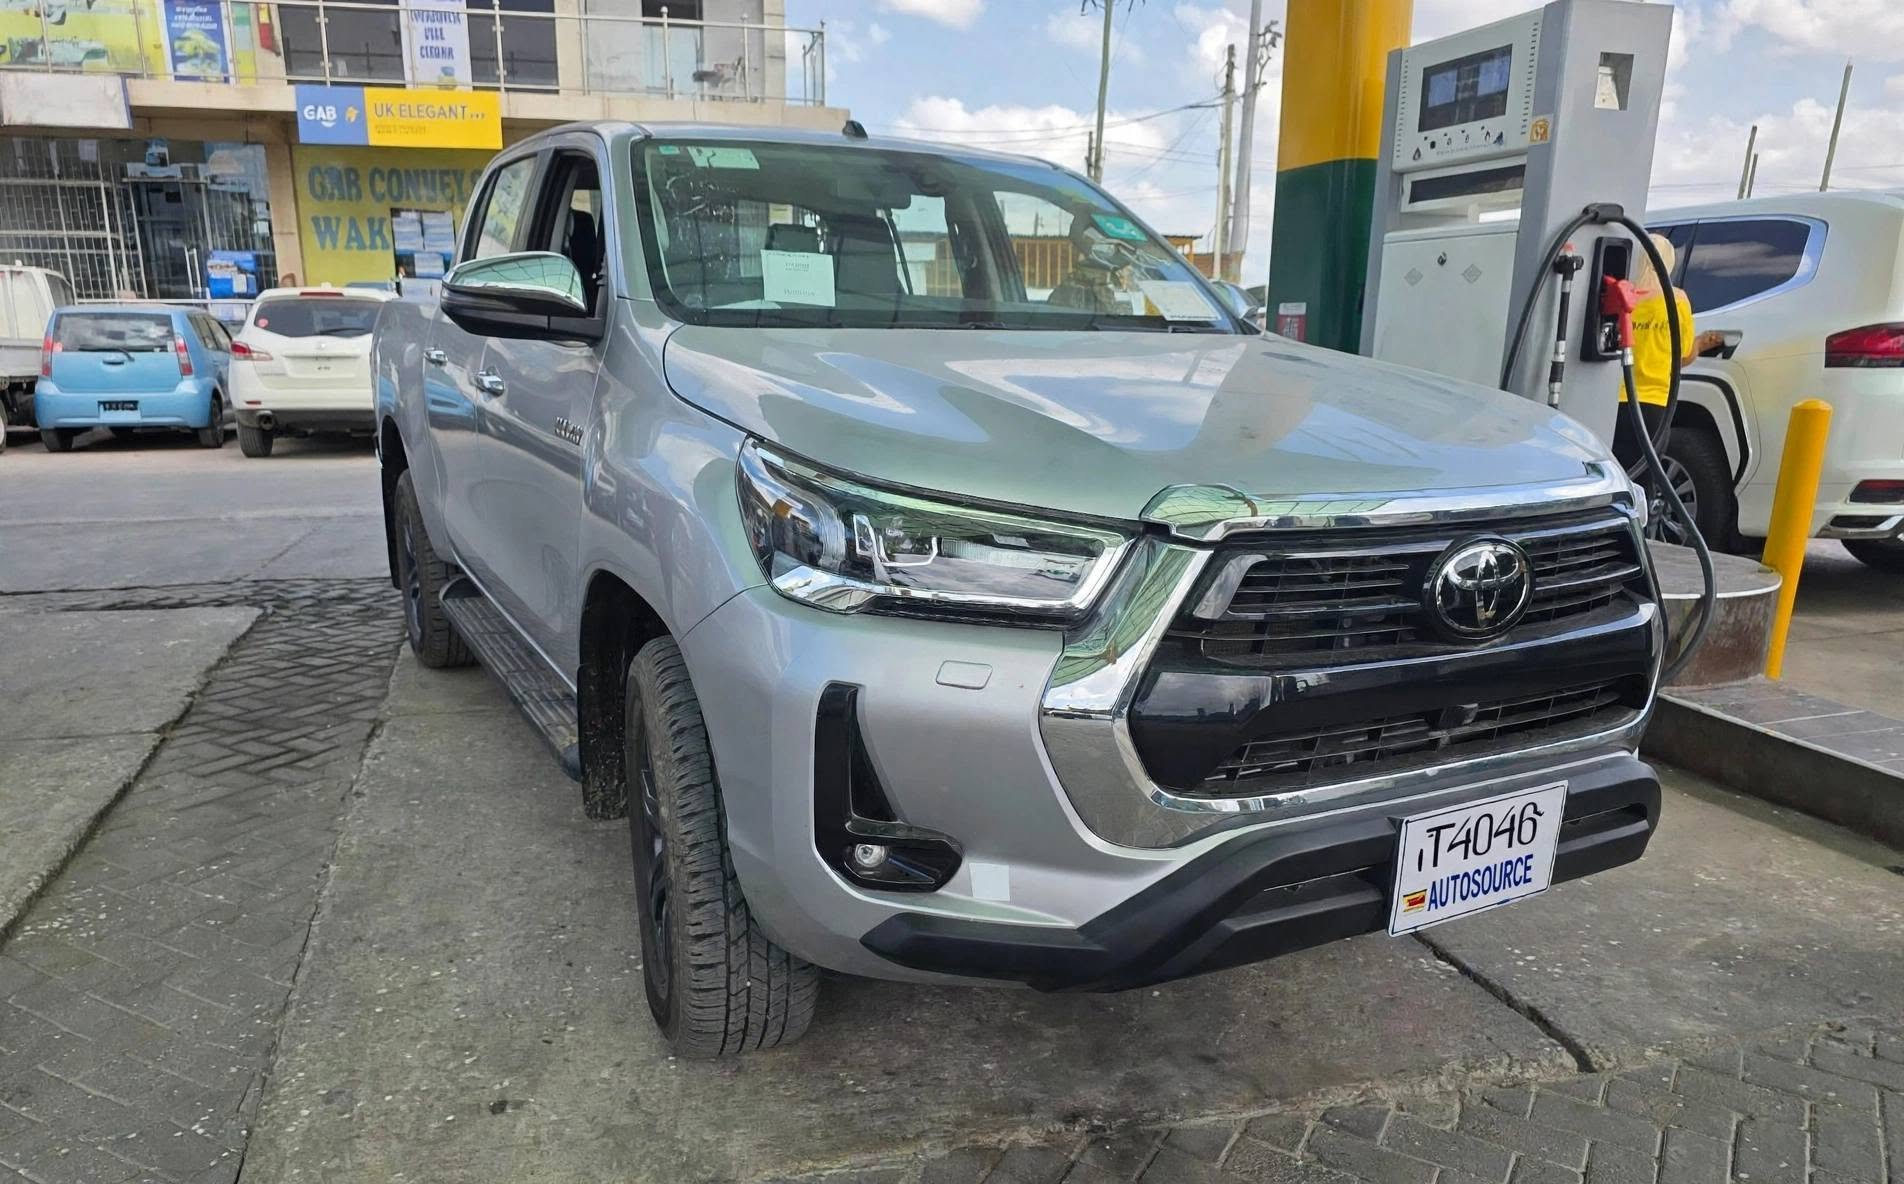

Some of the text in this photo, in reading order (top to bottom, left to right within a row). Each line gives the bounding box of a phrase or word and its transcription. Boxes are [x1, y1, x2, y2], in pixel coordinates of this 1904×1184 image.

[303, 104, 338, 122] GAB
[374, 103, 394, 118] UK
[1427, 853, 1534, 912] AUTOSOURCE
